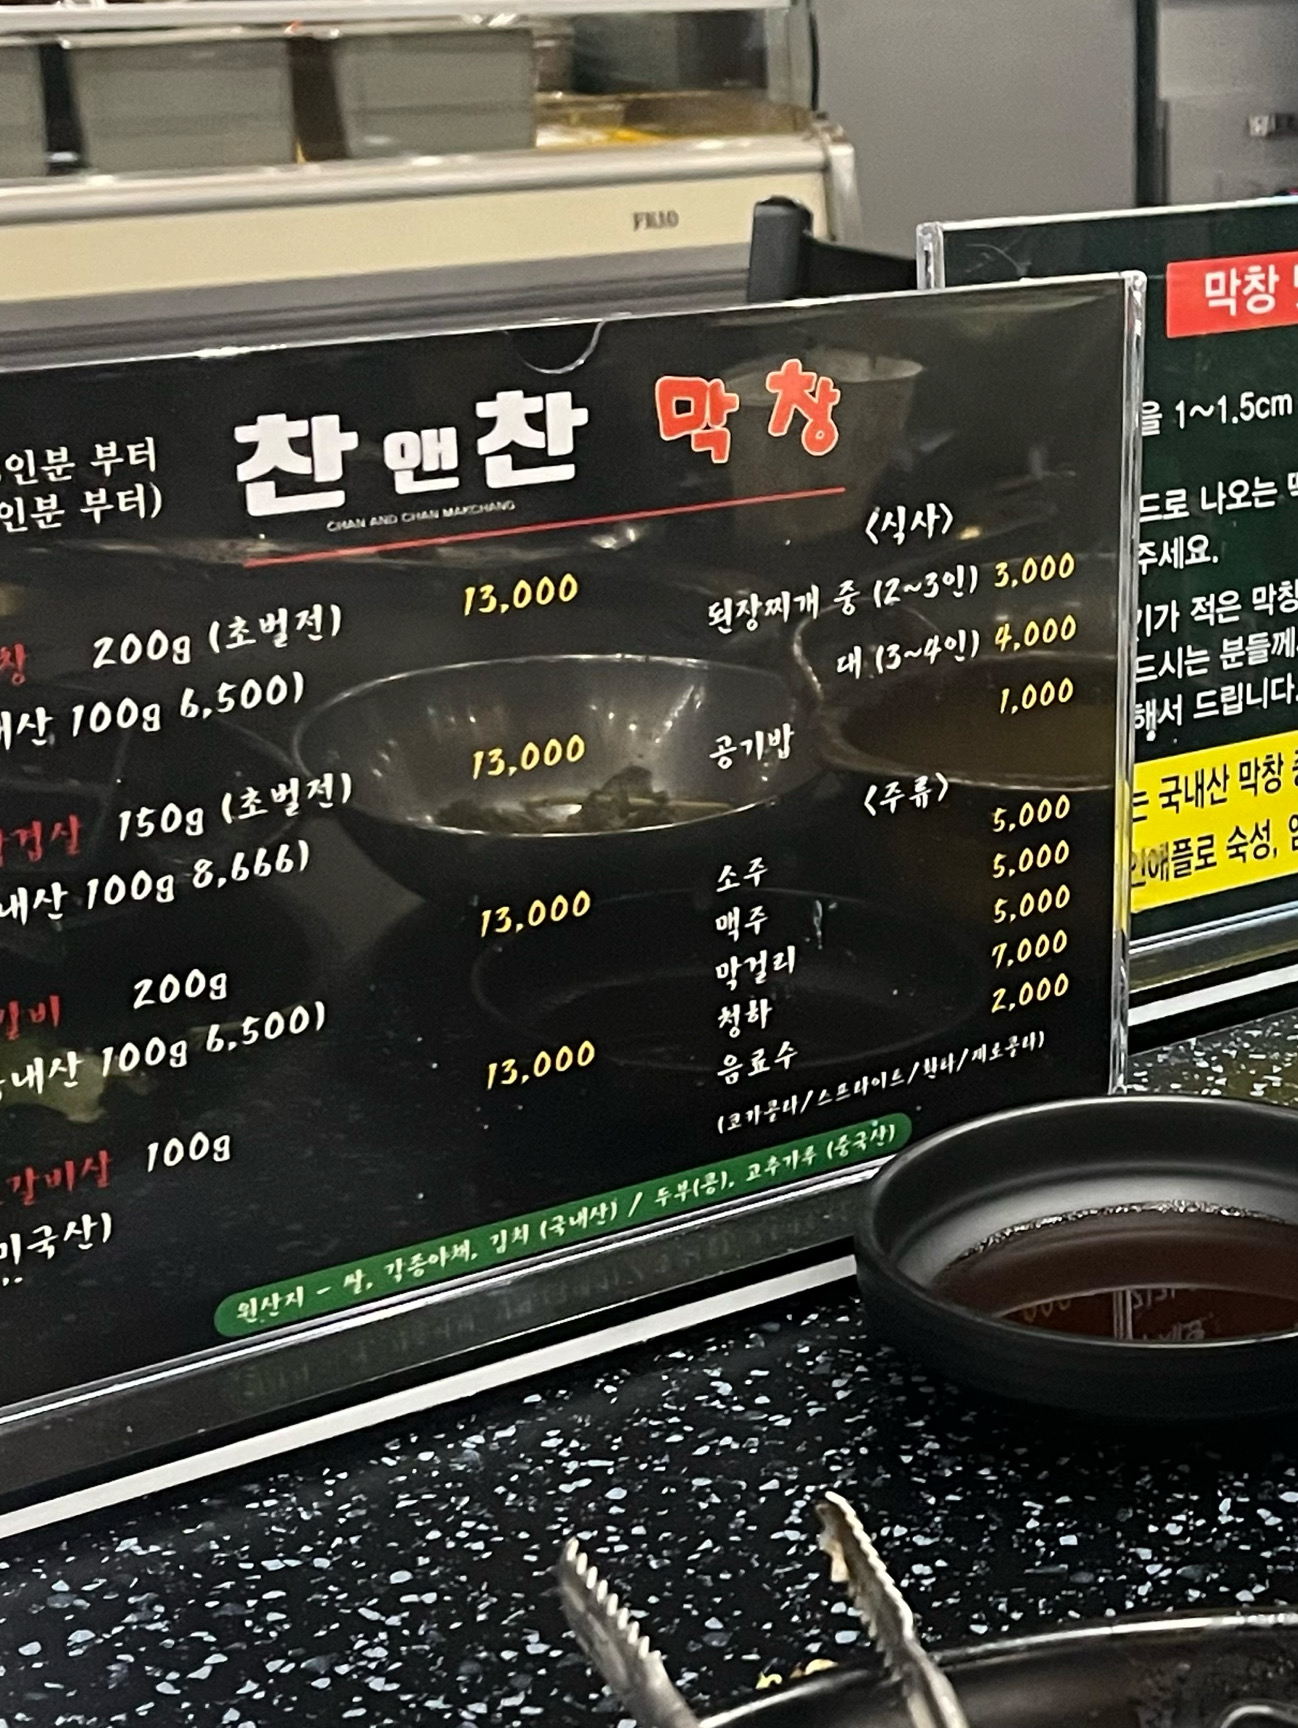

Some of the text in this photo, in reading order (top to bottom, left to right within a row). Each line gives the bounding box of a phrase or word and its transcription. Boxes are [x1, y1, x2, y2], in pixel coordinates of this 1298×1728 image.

[1203, 264, 1280, 318] 막창
[1176, 392, 1292, 429] 1~1.5cm
[0, 437, 155, 485] 인분 부터
[235, 414, 358, 516] 찬
[384, 427, 459, 494] 앤
[476, 390, 588, 488] 찬
[0, 483, 161, 532] 인분 부터)
[327, 500, 515, 532] CHAN AND CHAN MAKCHANG
[1138, 489, 1189, 524] 드로
[1201, 477, 1277, 515] 나오는
[1136, 533, 1218, 576] 주세요.
[465, 574, 577, 615] 13,000
[709, 553, 1074, 634] 된장찌개 중 (2~3인) 3,000
[1191, 591, 1241, 626] 적은
[93, 630, 190, 668] 200g
[209, 604, 340, 653] (초벌전)
[837, 615, 1076, 679] 대 (3~4인) 4,000
[1134, 642, 1210, 683] 드시는
[73, 698, 160, 736] 100g
[181, 672, 303, 718] 6,500)
[710, 678, 1073, 769] 공기밥 1,000
[473, 735, 584, 779] 13,000
[120, 803, 203, 841] 150g
[222, 773, 351, 824] (초벌전)
[1159, 764, 1229, 814] 국내산
[1239, 753, 1283, 796] 막창
[994, 795, 1070, 832] 5,000
[1227, 819, 1277, 863] 숙성,
[87, 870, 174, 909] 100g
[193, 840, 308, 888] 8,666)
[717, 840, 1069, 892] 소주 5,000
[482, 891, 590, 937] 13,000
[716, 885, 1070, 941] 맥주 5,000
[716, 930, 1067, 990] 막걸리 7,000
[134, 969, 226, 1009] 200g
[718, 973, 1068, 1038] 청하 2,000
[0, 1001, 324, 1099] 내산 100g 6,500)
[488, 1041, 594, 1089] 13,000
[718, 1041, 797, 1084] 음료수
[148, 1132, 230, 1172] 100g
[237, 1286, 303, 1323] 원산지
[490, 1224, 528, 1253] 김치
[540, 1198, 619, 1241] (국내산)
[827, 1124, 896, 1161] (중국산)
